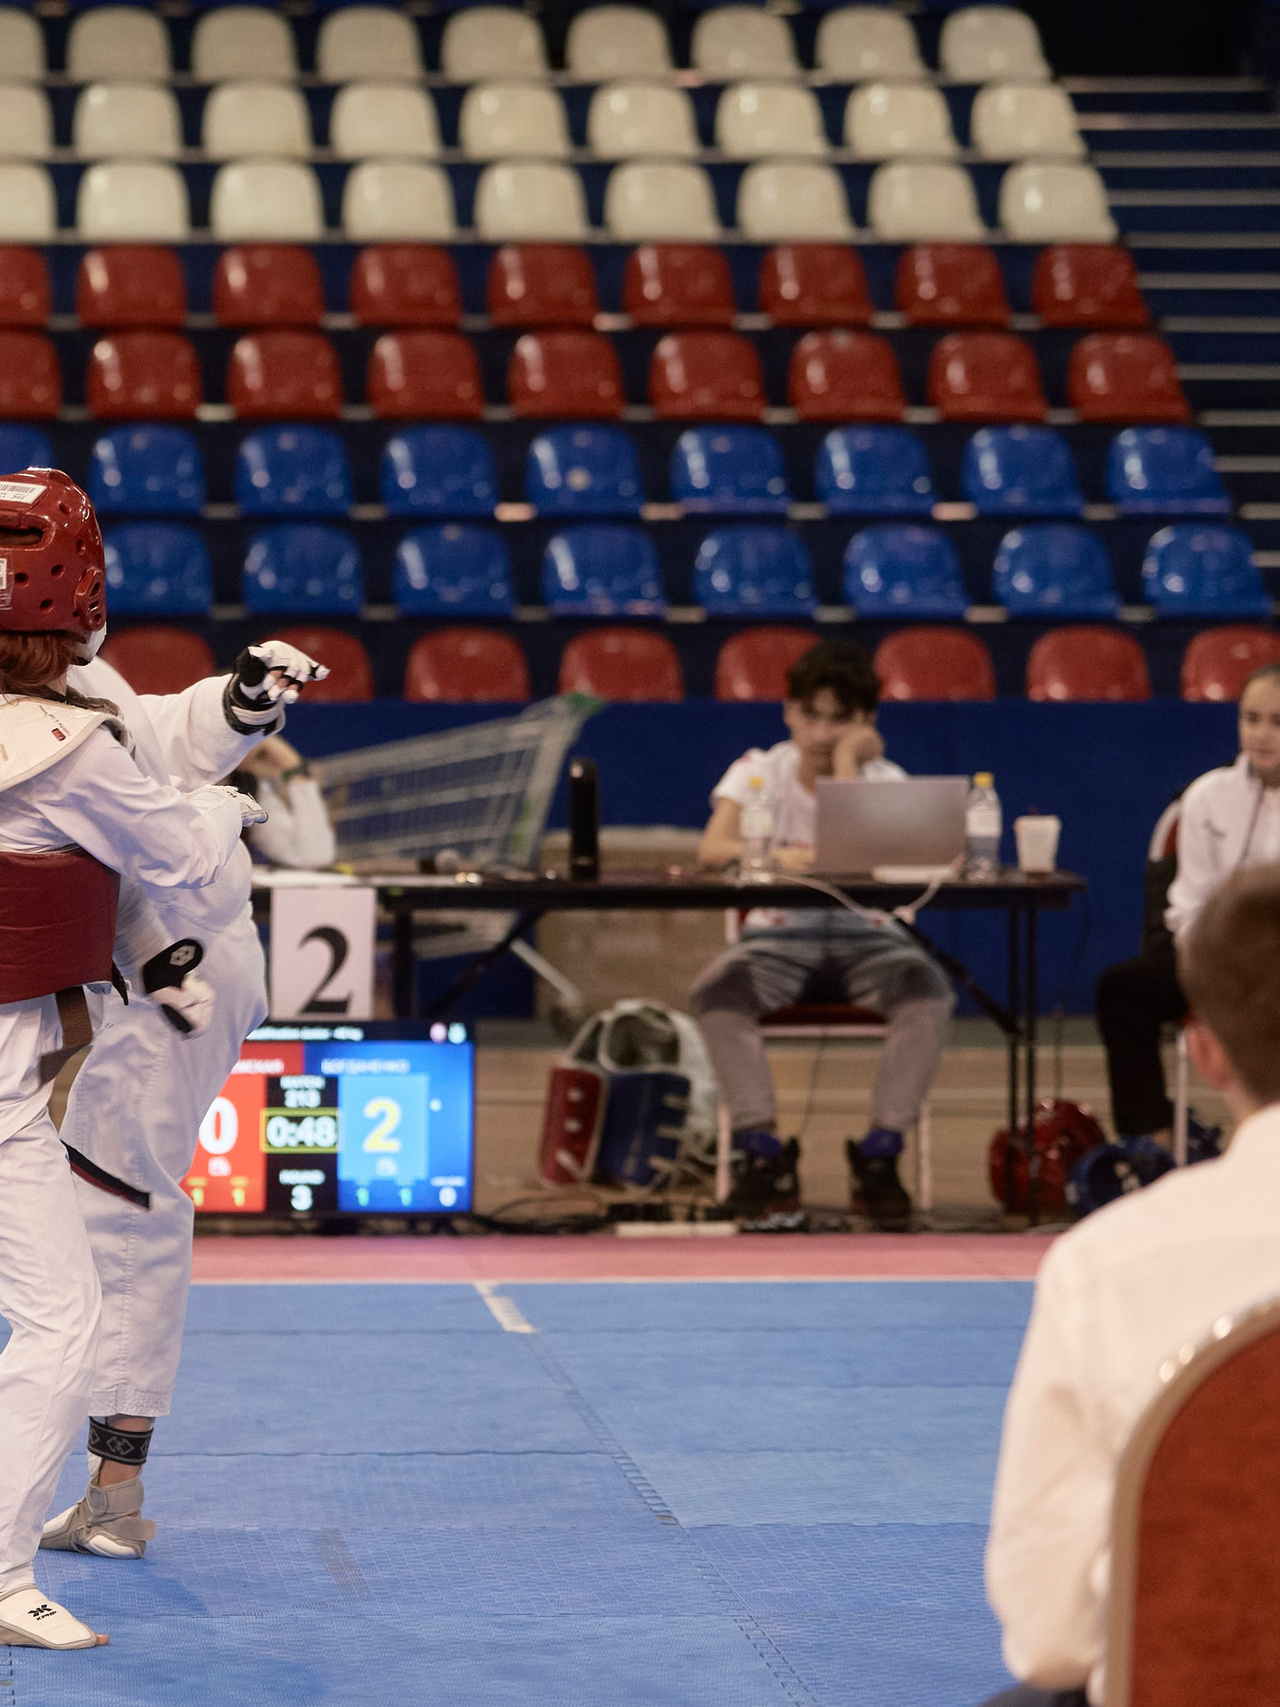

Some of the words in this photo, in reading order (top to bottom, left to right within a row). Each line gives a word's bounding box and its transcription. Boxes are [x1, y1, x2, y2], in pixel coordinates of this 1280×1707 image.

[298, 925, 353, 1014] 2
[199, 1097, 238, 1154] 0
[266, 1115, 338, 1148] 0:48
[362, 1098, 402, 1153] 2
[291, 1184, 312, 1211] 3
